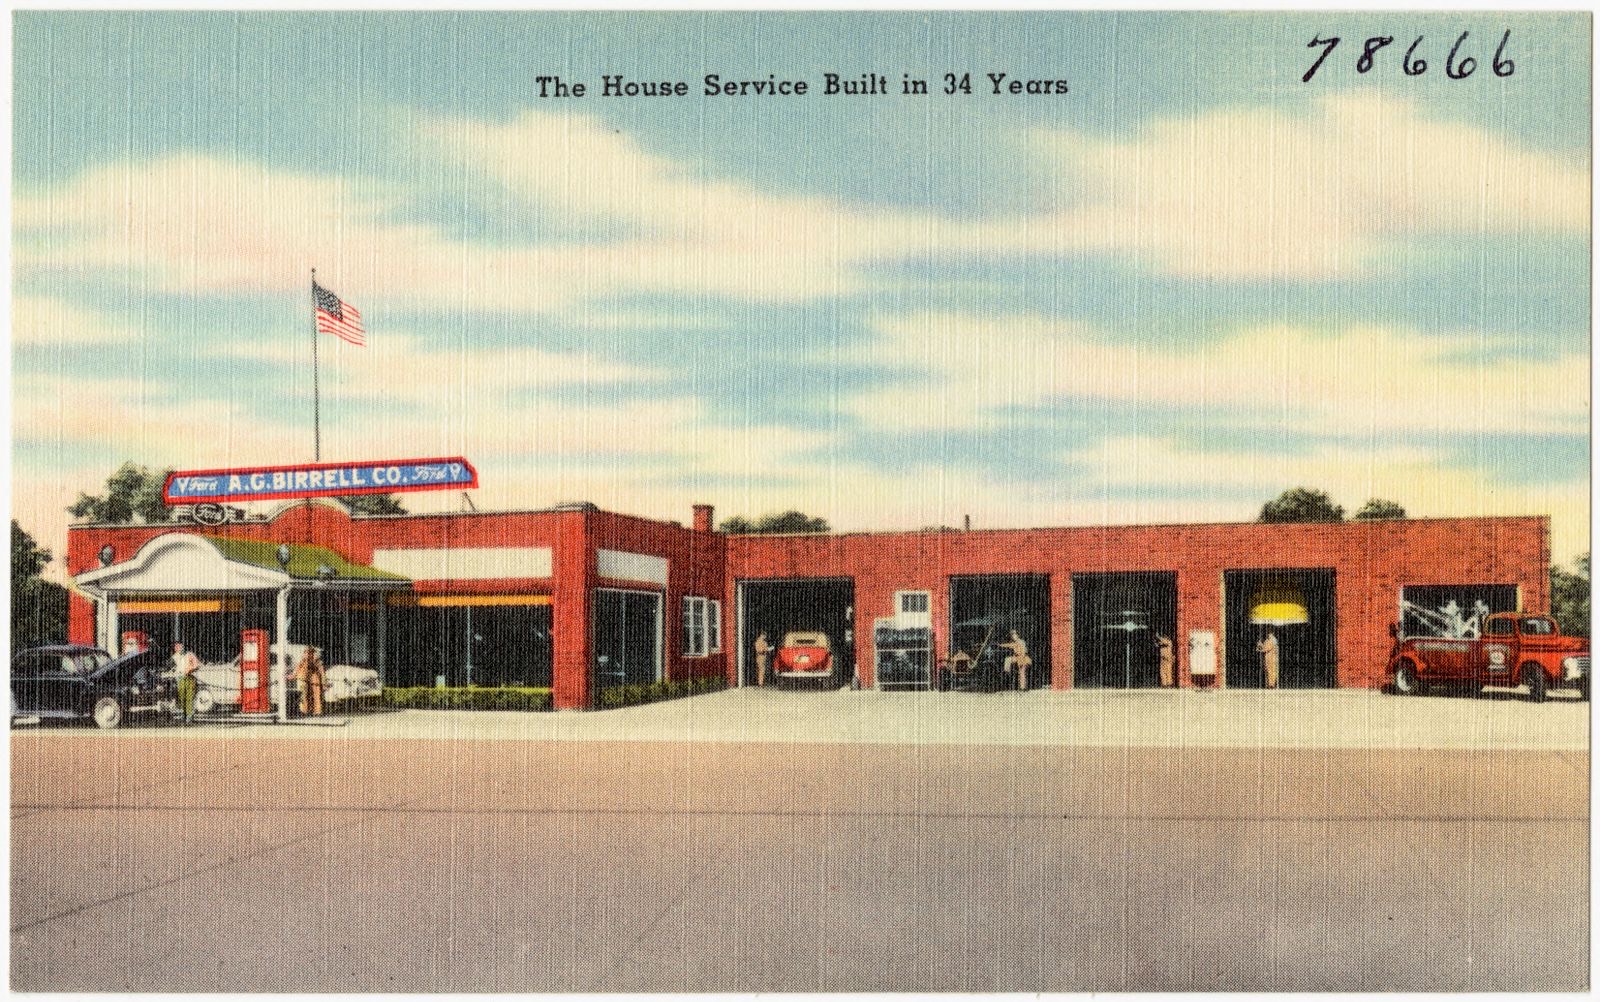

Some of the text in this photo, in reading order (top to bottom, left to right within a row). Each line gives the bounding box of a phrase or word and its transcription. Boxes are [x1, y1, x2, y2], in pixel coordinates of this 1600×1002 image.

[1302, 29, 1515, 83] 78666
[188, 476, 218, 492] Ford
[372, 466, 408, 485] CO.
[411, 464, 447, 481] Ford
